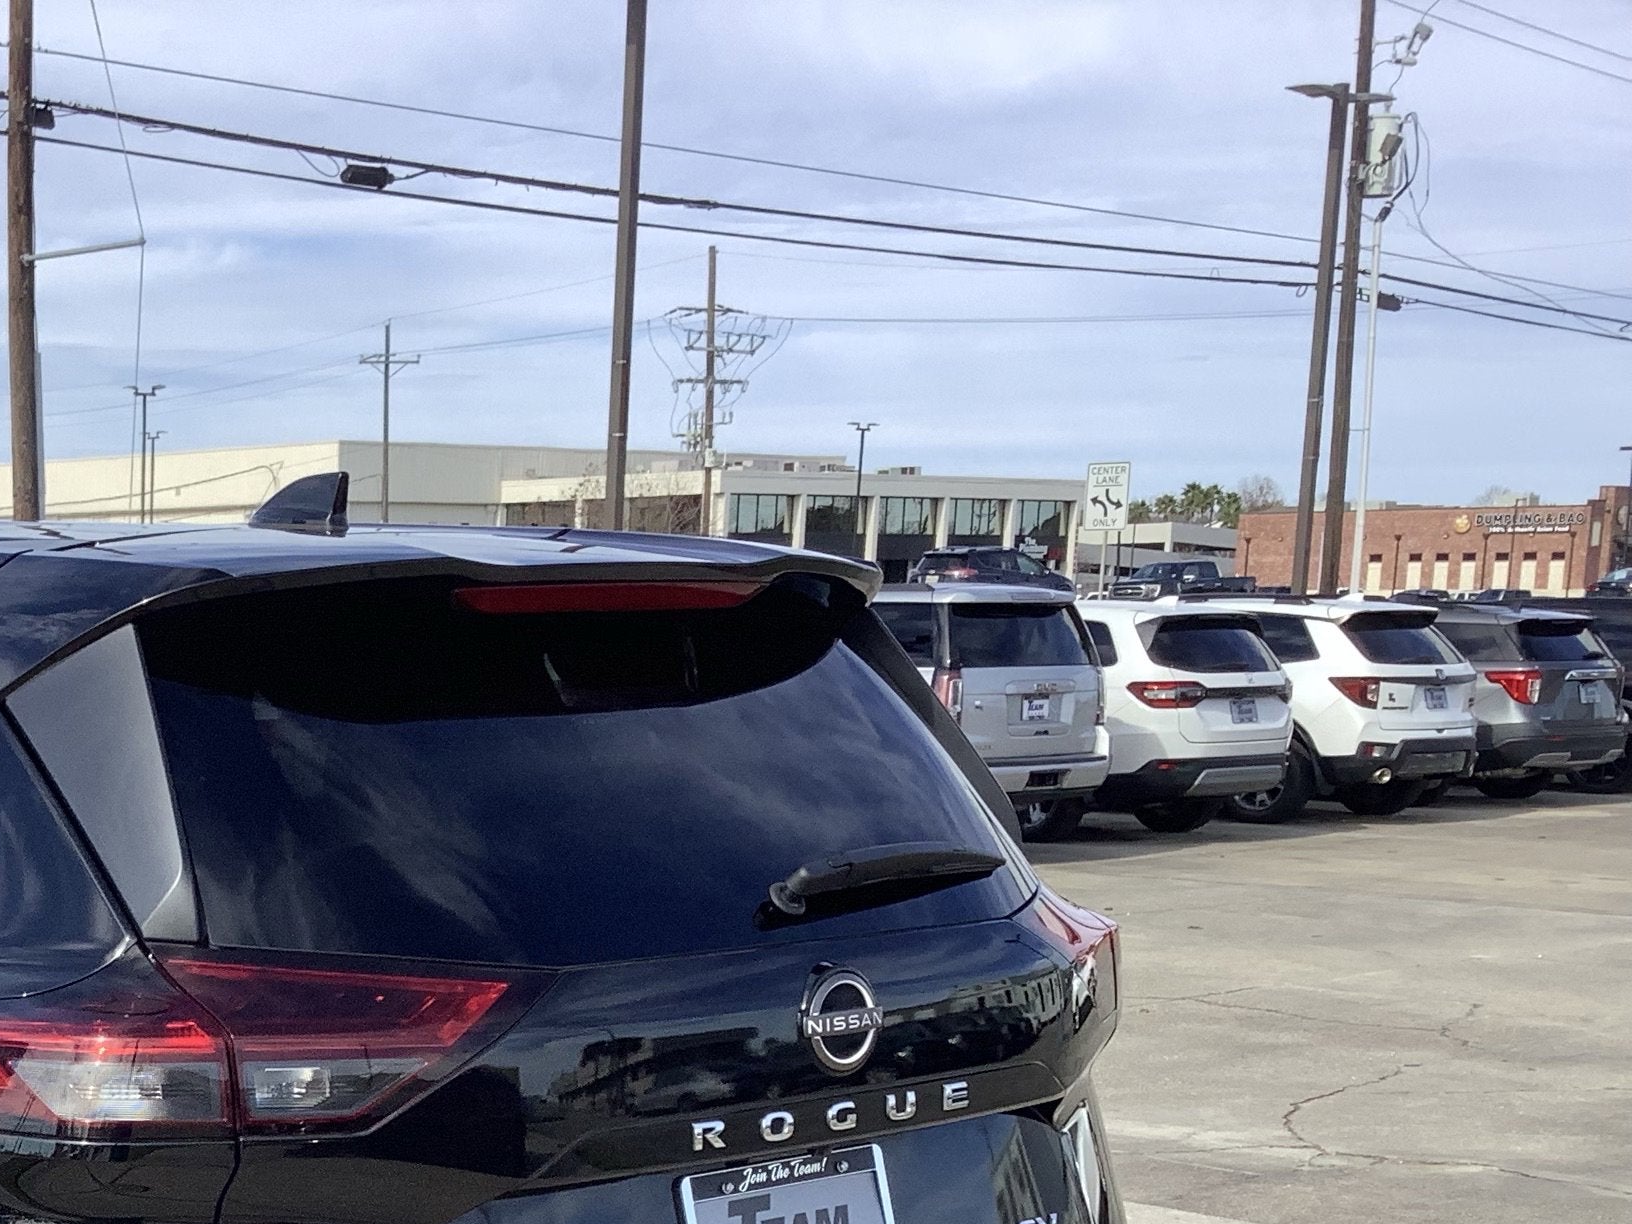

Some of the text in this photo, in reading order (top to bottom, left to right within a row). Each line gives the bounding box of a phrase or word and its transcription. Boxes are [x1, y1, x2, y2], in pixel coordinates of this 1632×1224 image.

[1091, 466, 1127, 476] CENTER
[1096, 476, 1121, 485] LANE
[1093, 518, 1117, 527] ONLY
[1546, 513, 1556, 524] &
[1559, 512, 1585, 526] BAO
[807, 1011, 882, 1036] NISSAN
[691, 1081, 970, 1152] ROGUE
[739, 1156, 828, 1192] Join The Team!
